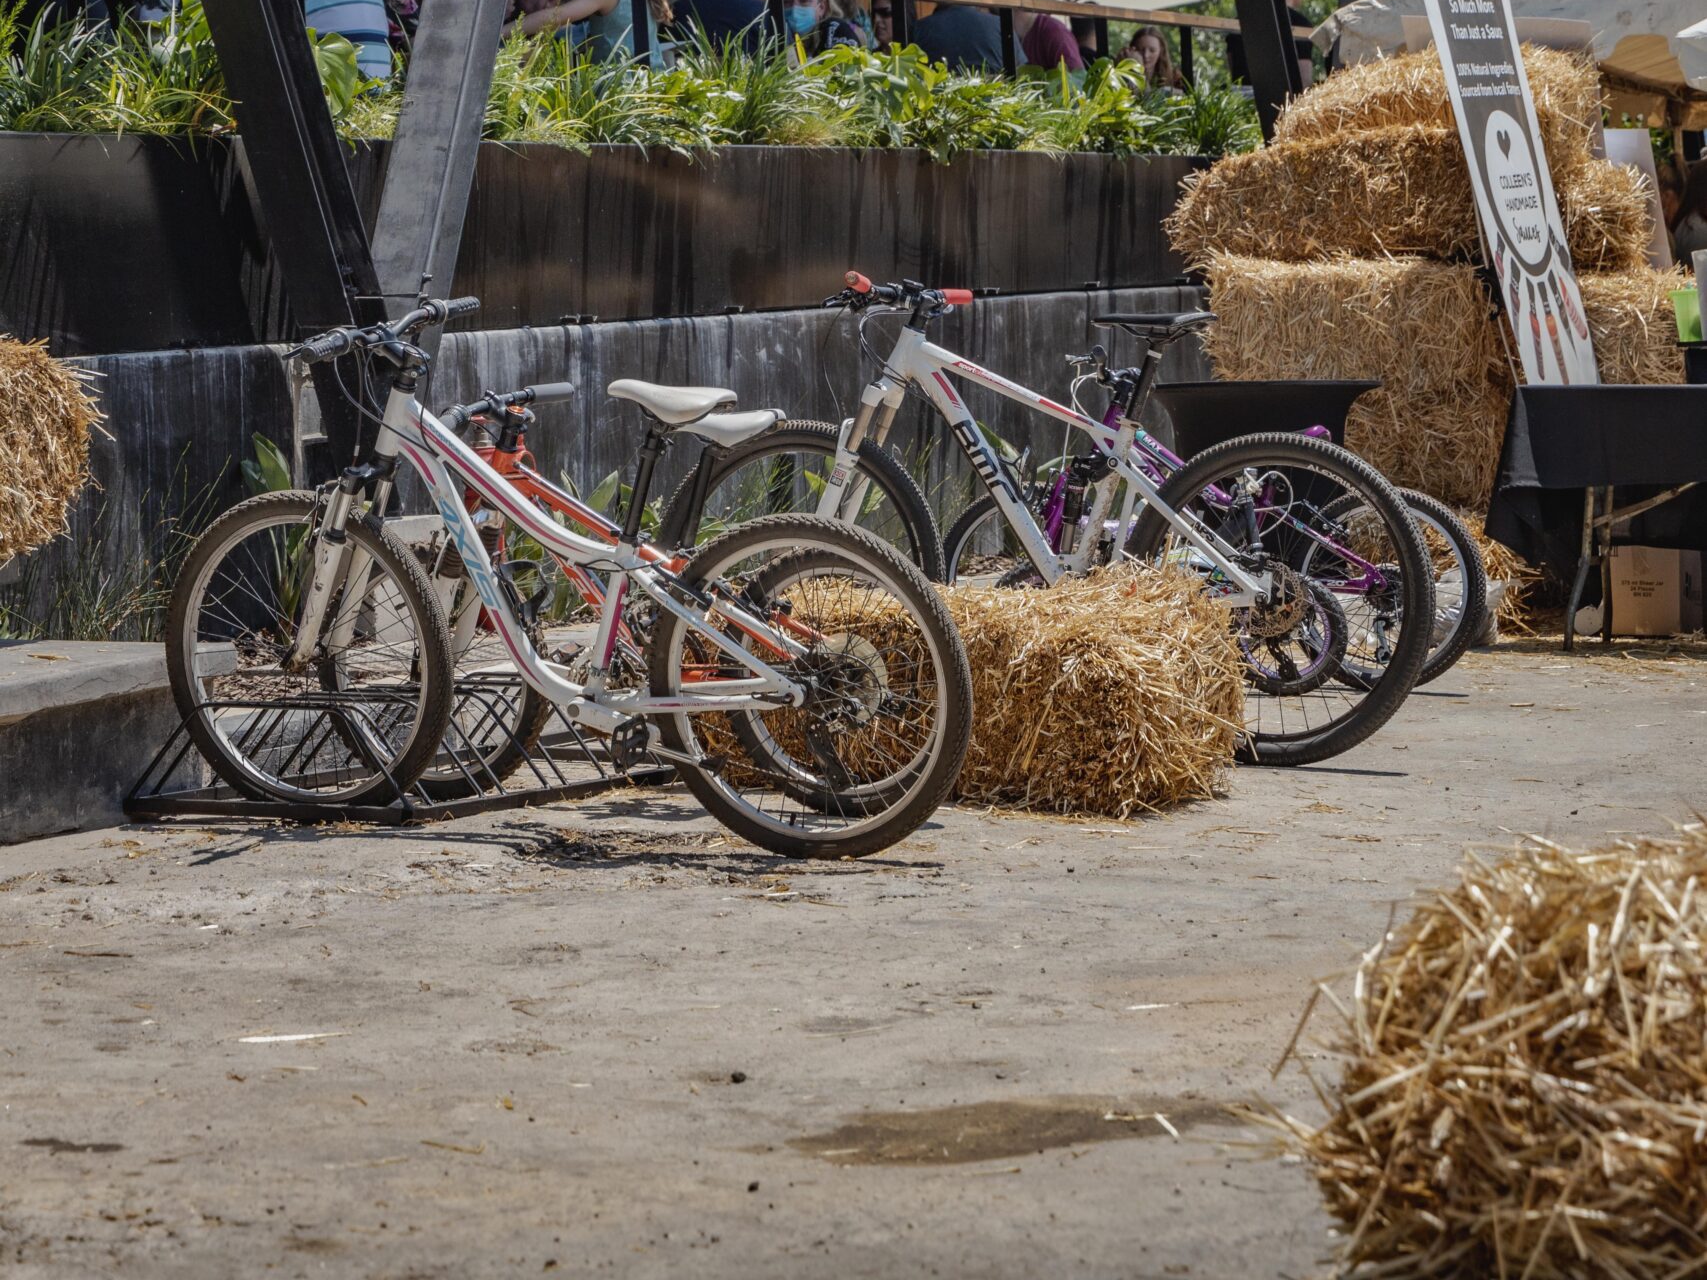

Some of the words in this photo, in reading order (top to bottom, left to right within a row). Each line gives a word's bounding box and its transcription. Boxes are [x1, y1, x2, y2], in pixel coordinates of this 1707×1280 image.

[1450, 23, 1469, 40] Than
[1467, 24, 1481, 39] Just
[1456, 62, 1472, 76] 100%
[1471, 61, 1490, 76] Natural
[1460, 83, 1481, 97] Sourced
[1479, 83, 1494, 96] from
[1492, 82, 1506, 96] local
[1500, 173, 1533, 190] COLLEEN'S
[1504, 195, 1538, 212] HANDMADE
[1142, 435, 1162, 452] MAX
[1191, 520, 1217, 542] APS
[438, 496, 503, 611] AXIS
